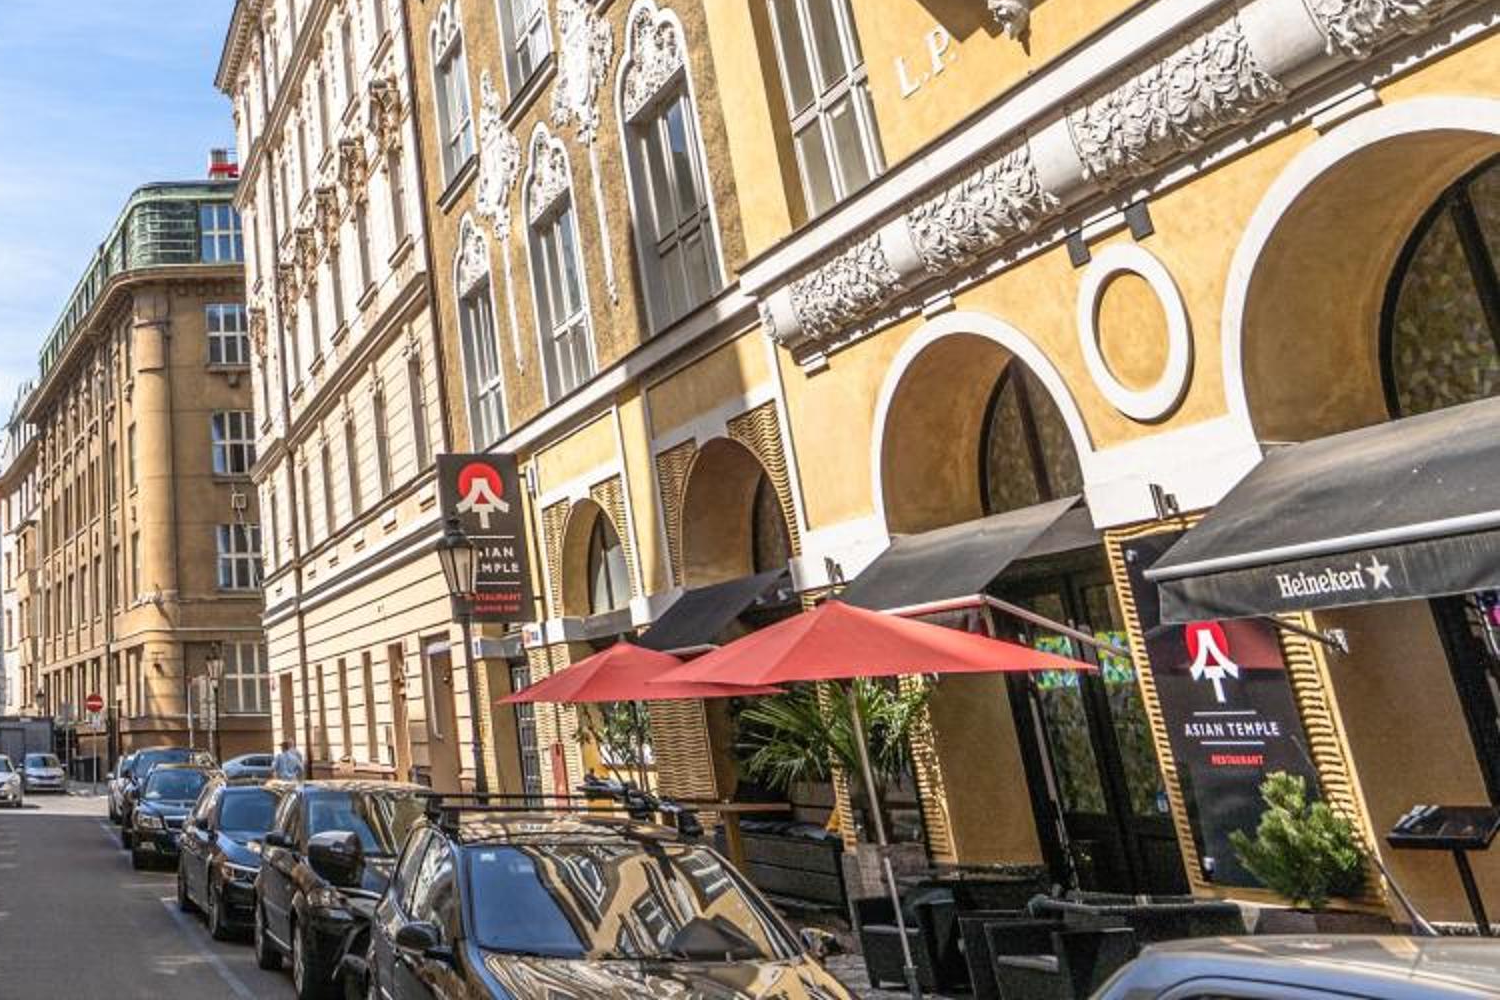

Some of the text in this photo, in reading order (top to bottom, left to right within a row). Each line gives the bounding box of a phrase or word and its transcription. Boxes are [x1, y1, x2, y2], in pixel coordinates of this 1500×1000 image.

[477, 562, 521, 574] MPLE
[1276, 564, 1365, 598] Heineken
[1185, 722, 1280, 737] ASIAN TEMPLE
